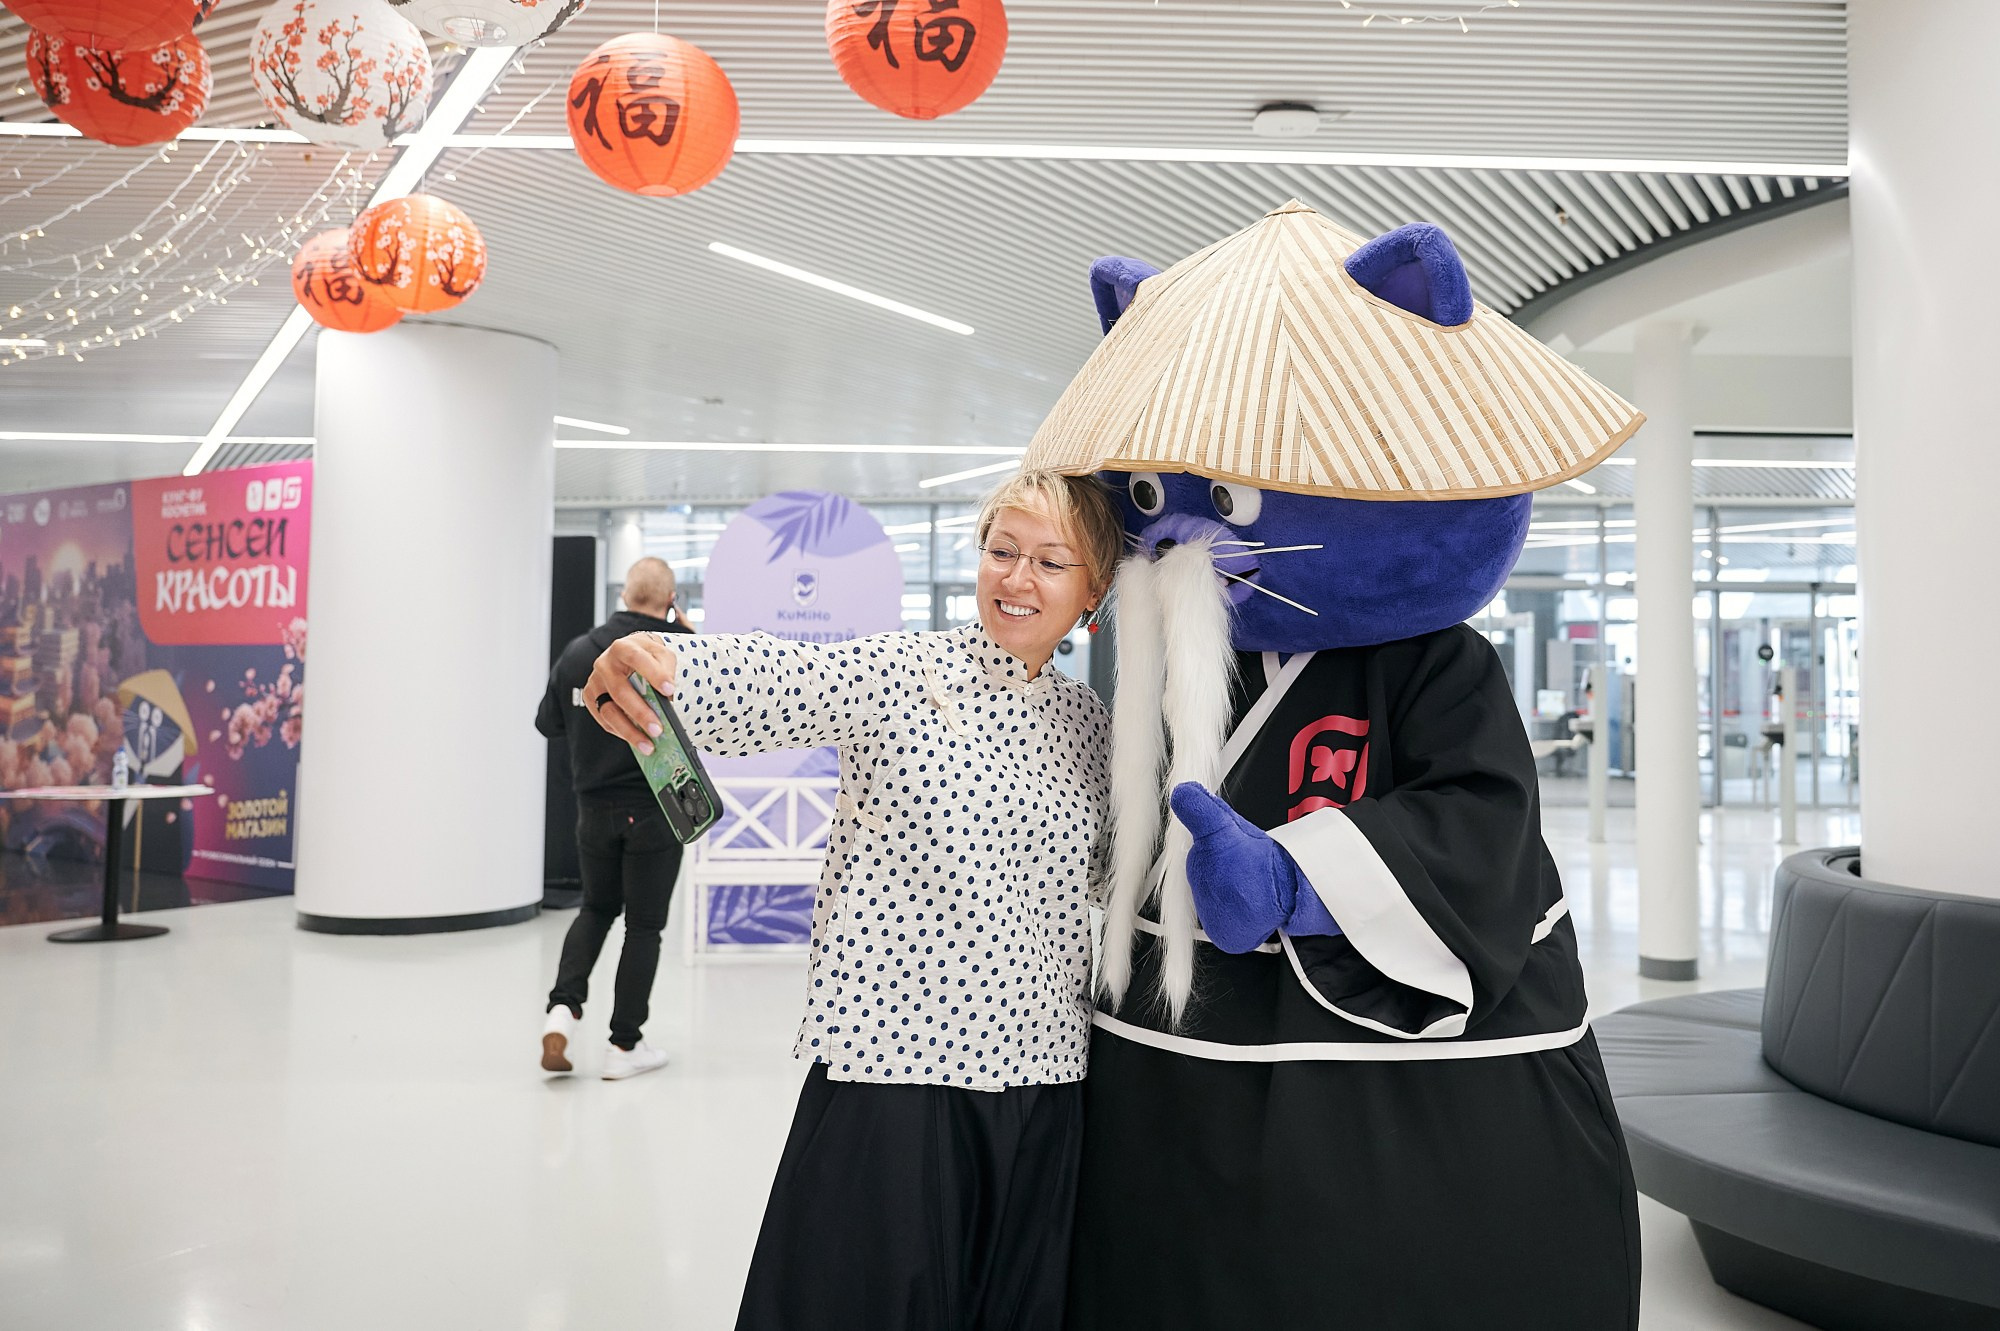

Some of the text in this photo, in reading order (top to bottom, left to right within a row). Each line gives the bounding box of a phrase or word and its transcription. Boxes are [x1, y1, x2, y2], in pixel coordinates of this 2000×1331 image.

[571, 51, 681, 151] 福
[155, 564, 297, 613] КРАСОТЫ
[225, 818, 287, 840] МАГАЗИН
